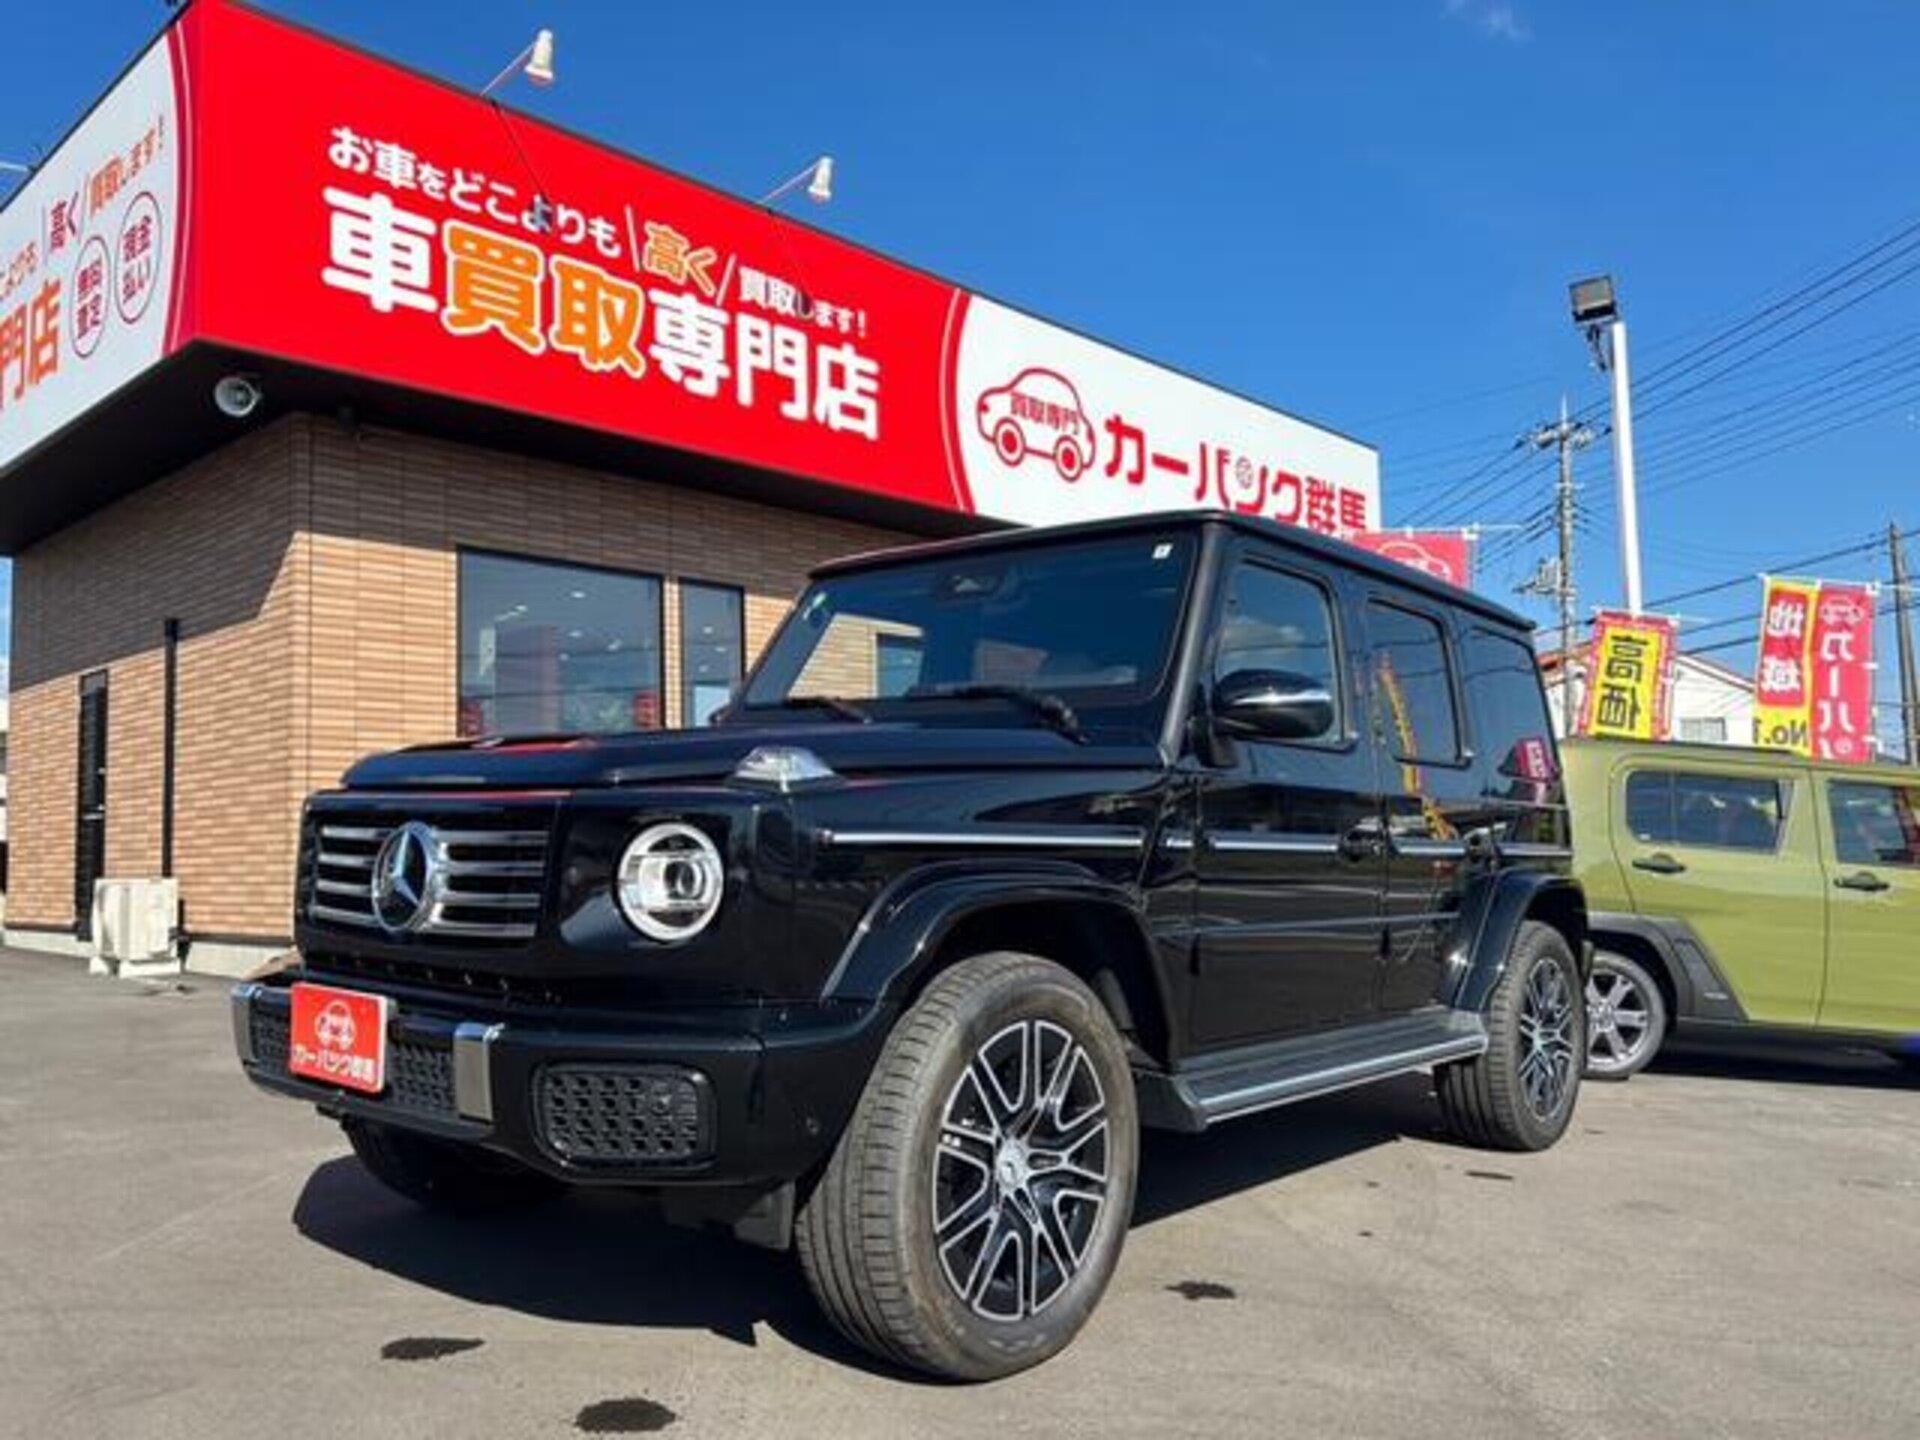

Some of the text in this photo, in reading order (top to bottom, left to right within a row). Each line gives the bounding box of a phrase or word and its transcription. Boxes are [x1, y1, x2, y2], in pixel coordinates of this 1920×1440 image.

[50, 190, 79, 250] 高く
[328, 126, 622, 259] お車をどこよりも
[643, 220, 718, 297] 高く
[322, 185, 881, 441] 車買取専門店
[1103, 414, 1368, 540] カーバンク群馬
